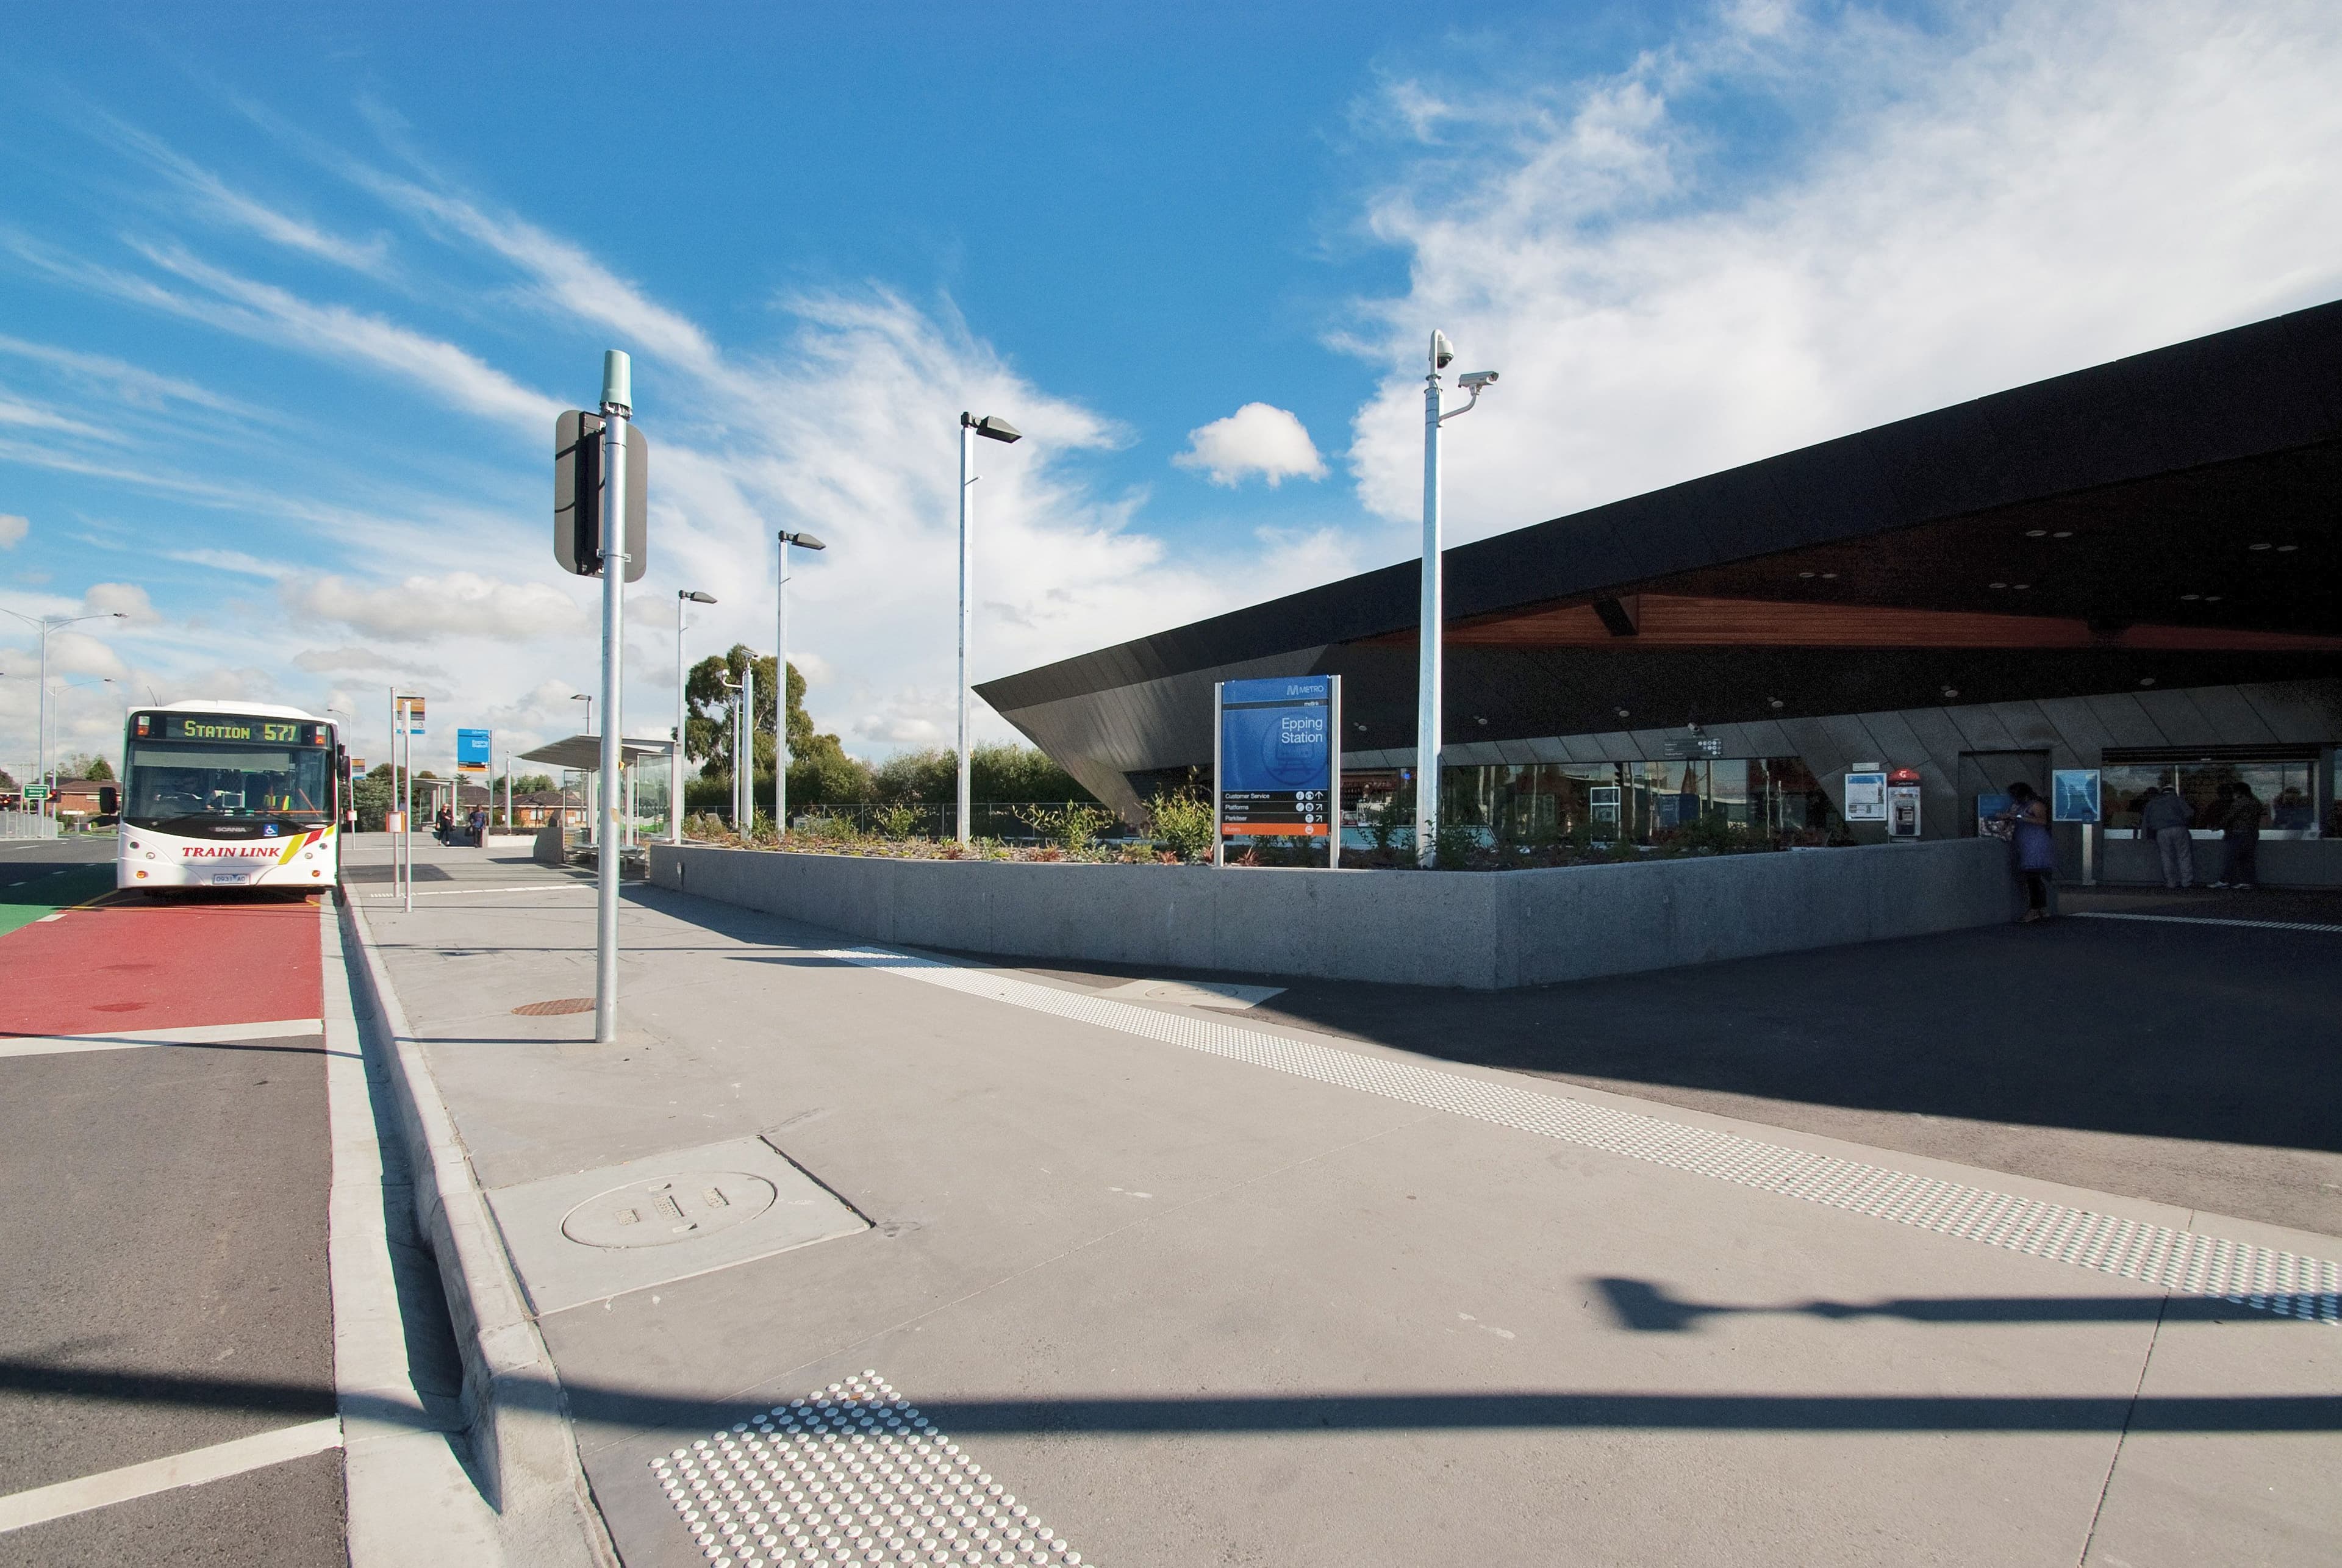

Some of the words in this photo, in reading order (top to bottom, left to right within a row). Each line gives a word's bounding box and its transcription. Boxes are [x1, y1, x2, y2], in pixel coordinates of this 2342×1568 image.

[1299, 685, 1324, 693] METRO
[1282, 717, 1322, 732] Epping
[1281, 732, 1323, 743] Station
[182, 847, 237, 857] TRAIN
[239, 847, 281, 857] LINK
